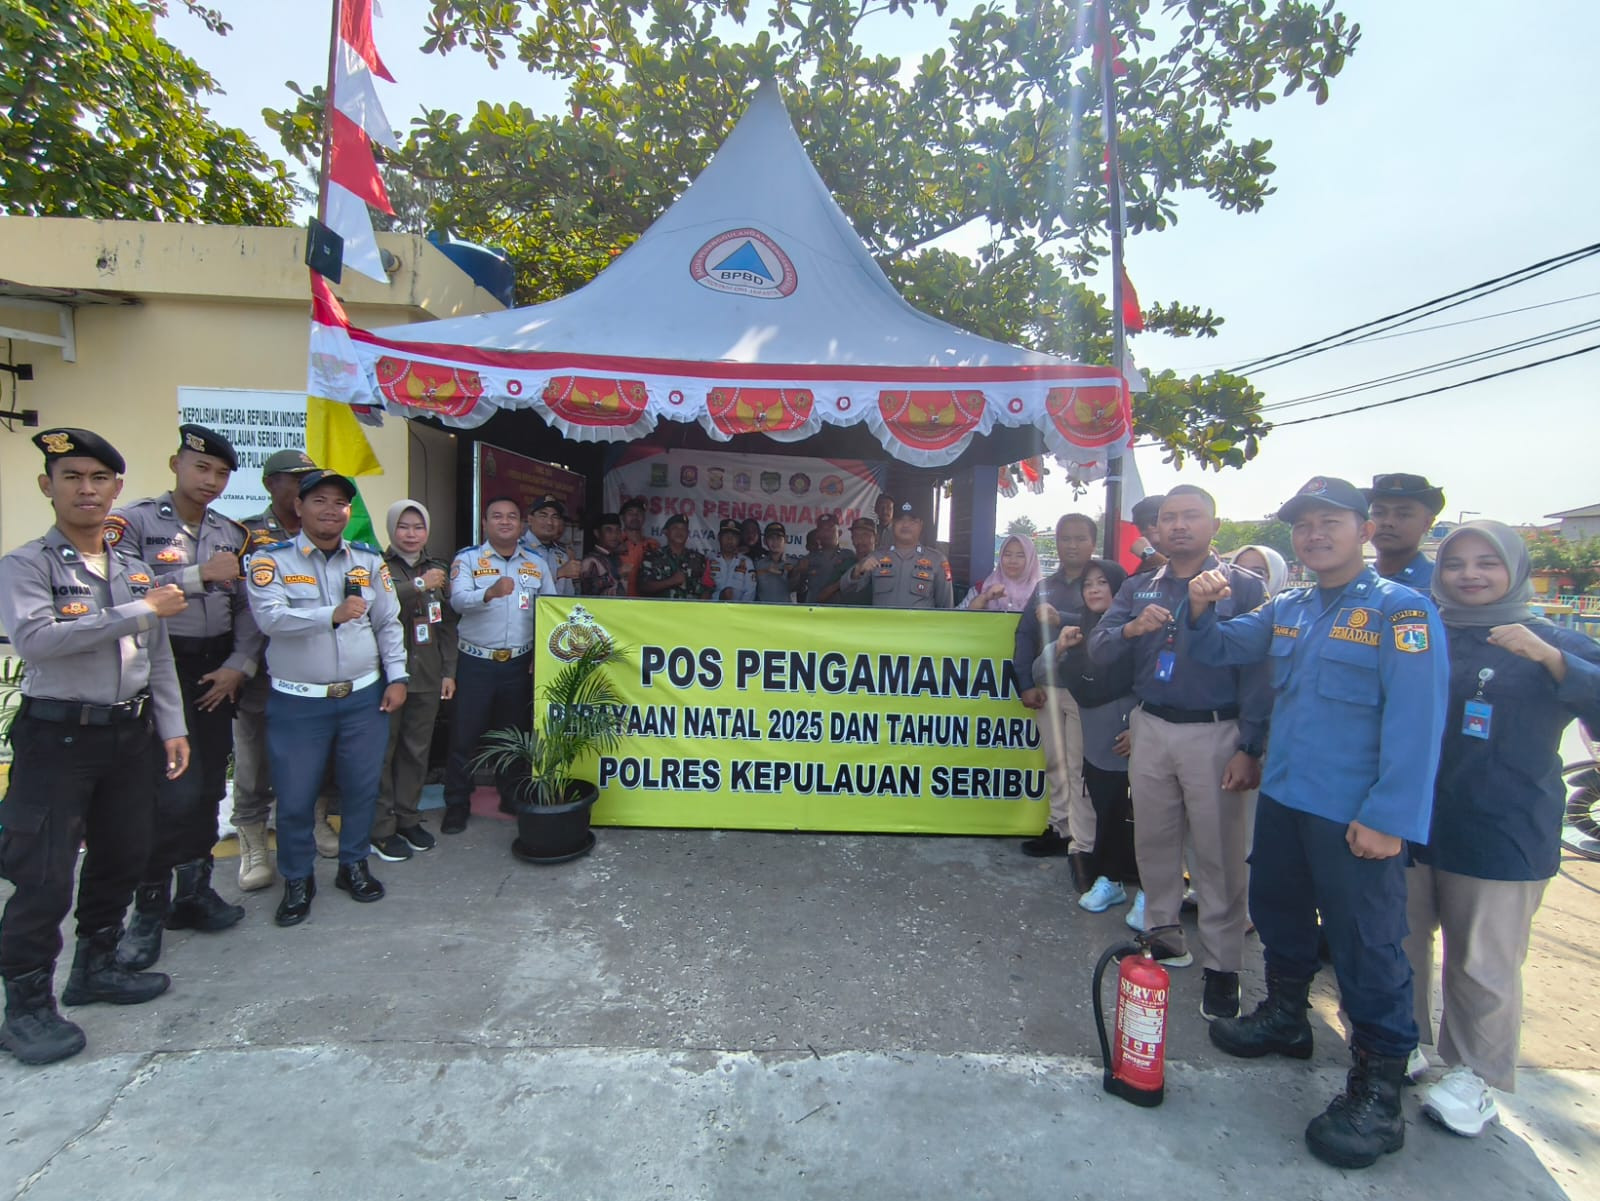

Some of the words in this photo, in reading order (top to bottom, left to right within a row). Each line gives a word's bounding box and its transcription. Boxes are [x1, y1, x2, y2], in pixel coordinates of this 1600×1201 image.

[720, 271, 764, 286] BPBD
[182, 407, 220, 424] KEPOLISIAN
[221, 408, 246, 425] NEGARA
[247, 409, 279, 427] REPUBLIK
[257, 430, 282, 448] SERIBU
[283, 432, 306, 449] UTARA
[1330, 626, 1381, 645] PEMADAM
[641, 646, 724, 690] POS
[736, 648, 1023, 700] PENGAMANAN
[683, 706, 762, 740] NATAL
[767, 709, 823, 742] 2025
[829, 711, 879, 745] DAN
[885, 713, 970, 747] TAHUN
[975, 716, 1042, 750] BARU
[598, 756, 722, 791] POLRES
[729, 759, 922, 797] KEPULAUAN
[929, 766, 1046, 800] SERIBU
